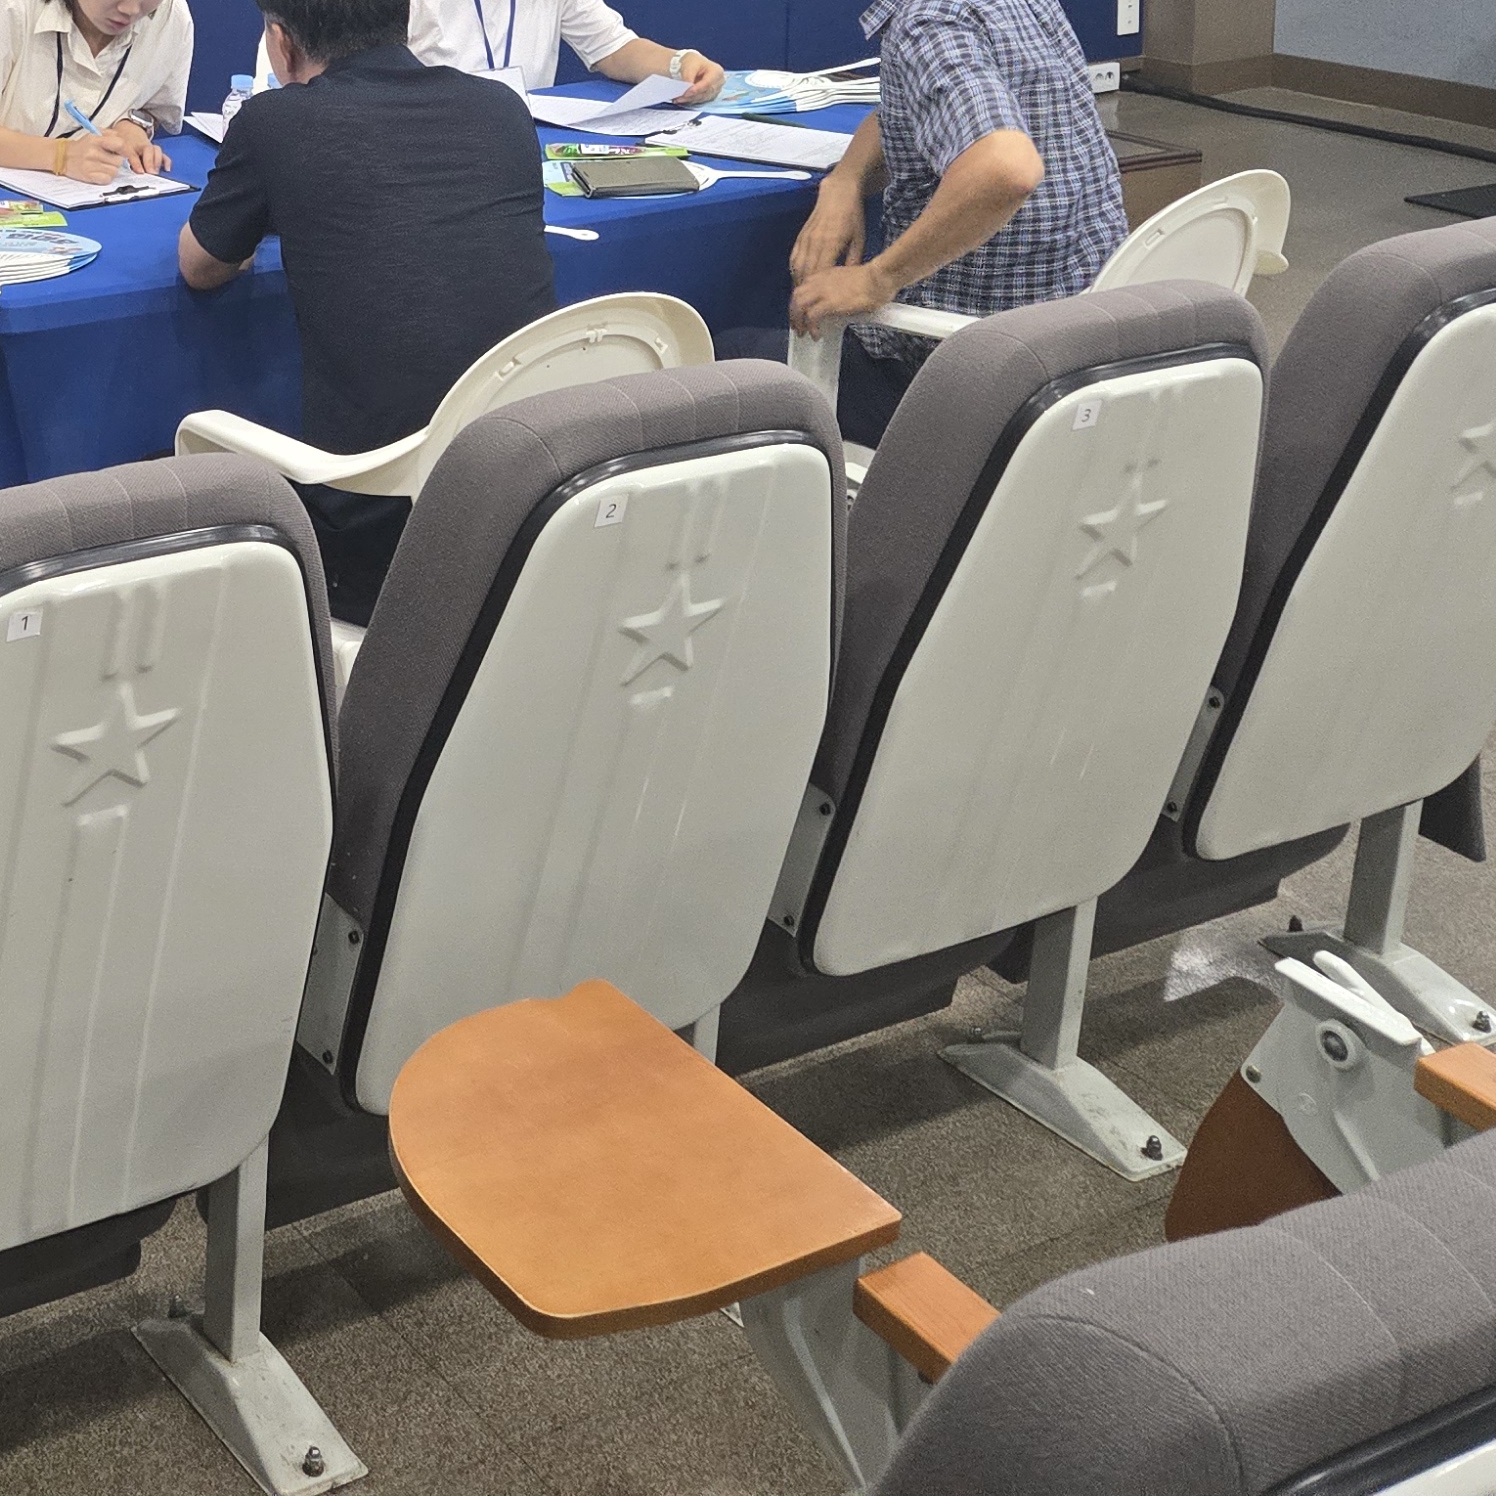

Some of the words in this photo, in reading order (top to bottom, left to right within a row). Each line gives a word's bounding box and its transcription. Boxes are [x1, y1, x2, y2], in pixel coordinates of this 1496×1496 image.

[1081, 408, 1092, 423] 3
[605, 503, 617, 519] 2
[21, 615, 29, 631] 1
